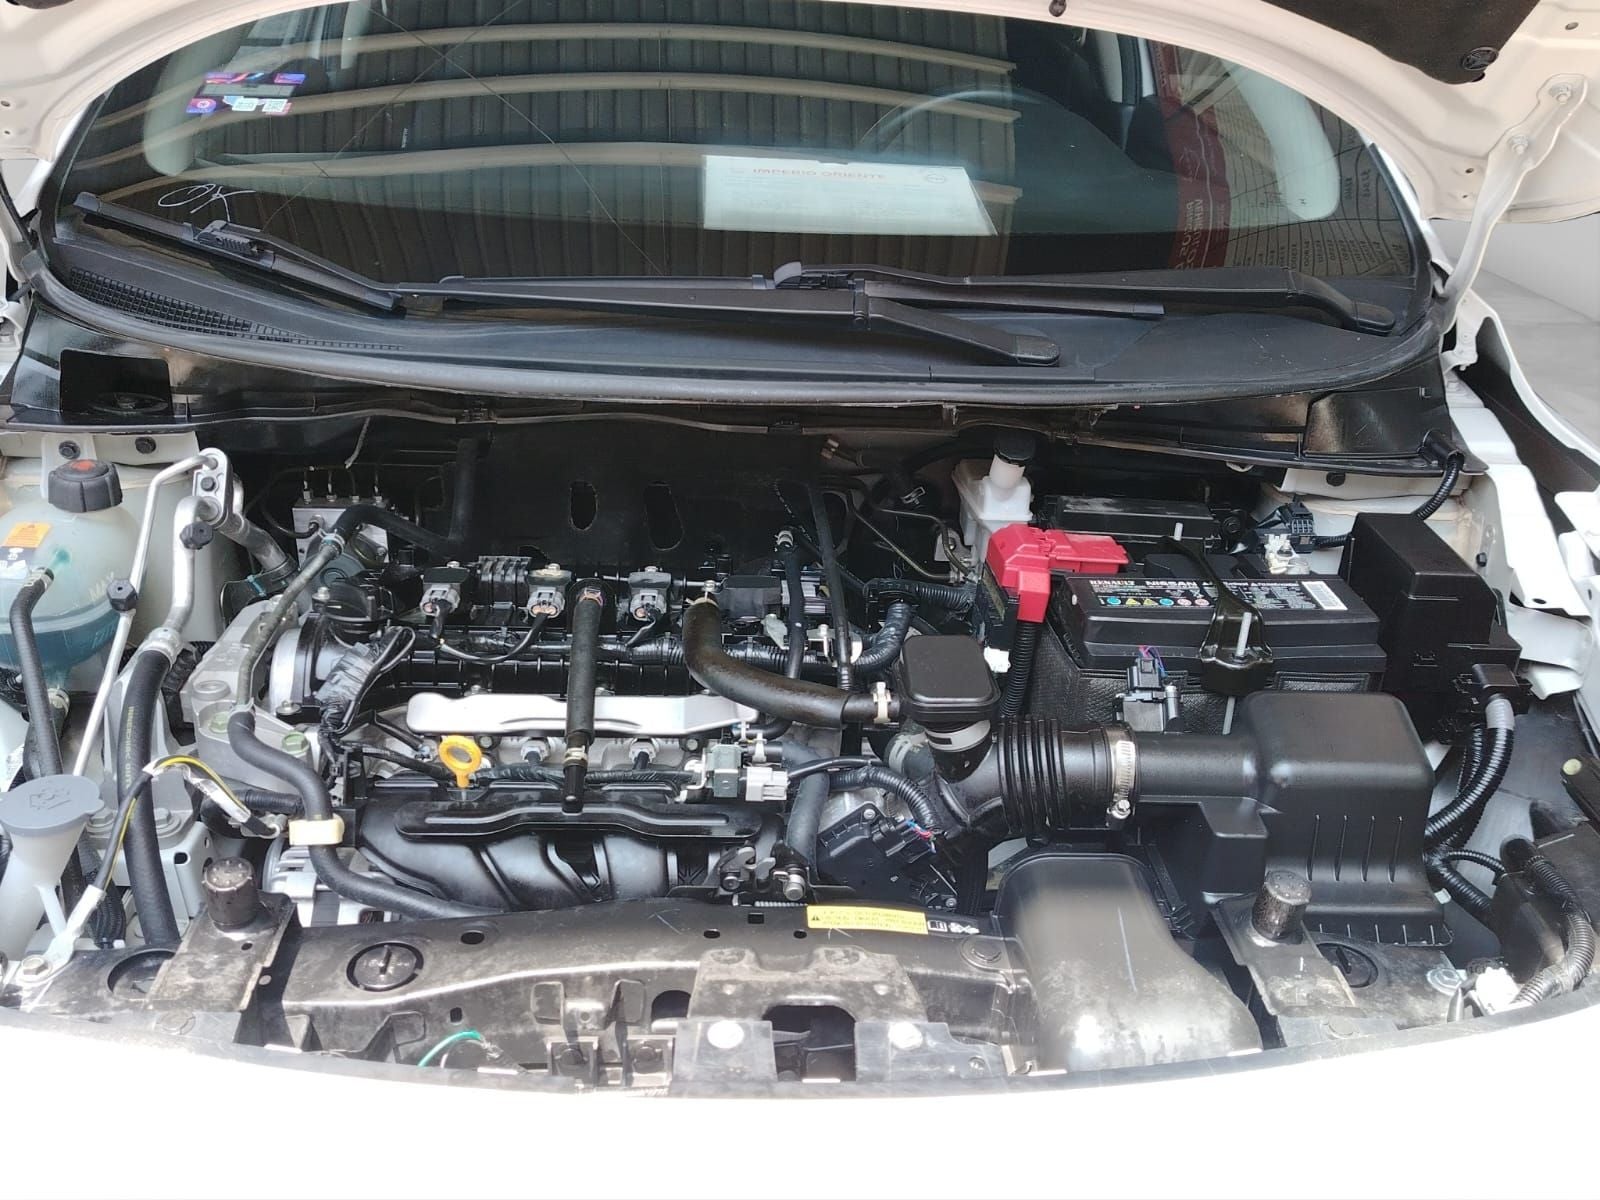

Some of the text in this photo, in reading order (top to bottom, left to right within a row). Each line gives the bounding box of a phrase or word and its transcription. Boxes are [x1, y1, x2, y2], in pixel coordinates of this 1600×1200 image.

[753, 167, 818, 177] IMPERIO
[1088, 578, 1136, 587] RENAULT
[1145, 579, 1199, 588] NISSAN
